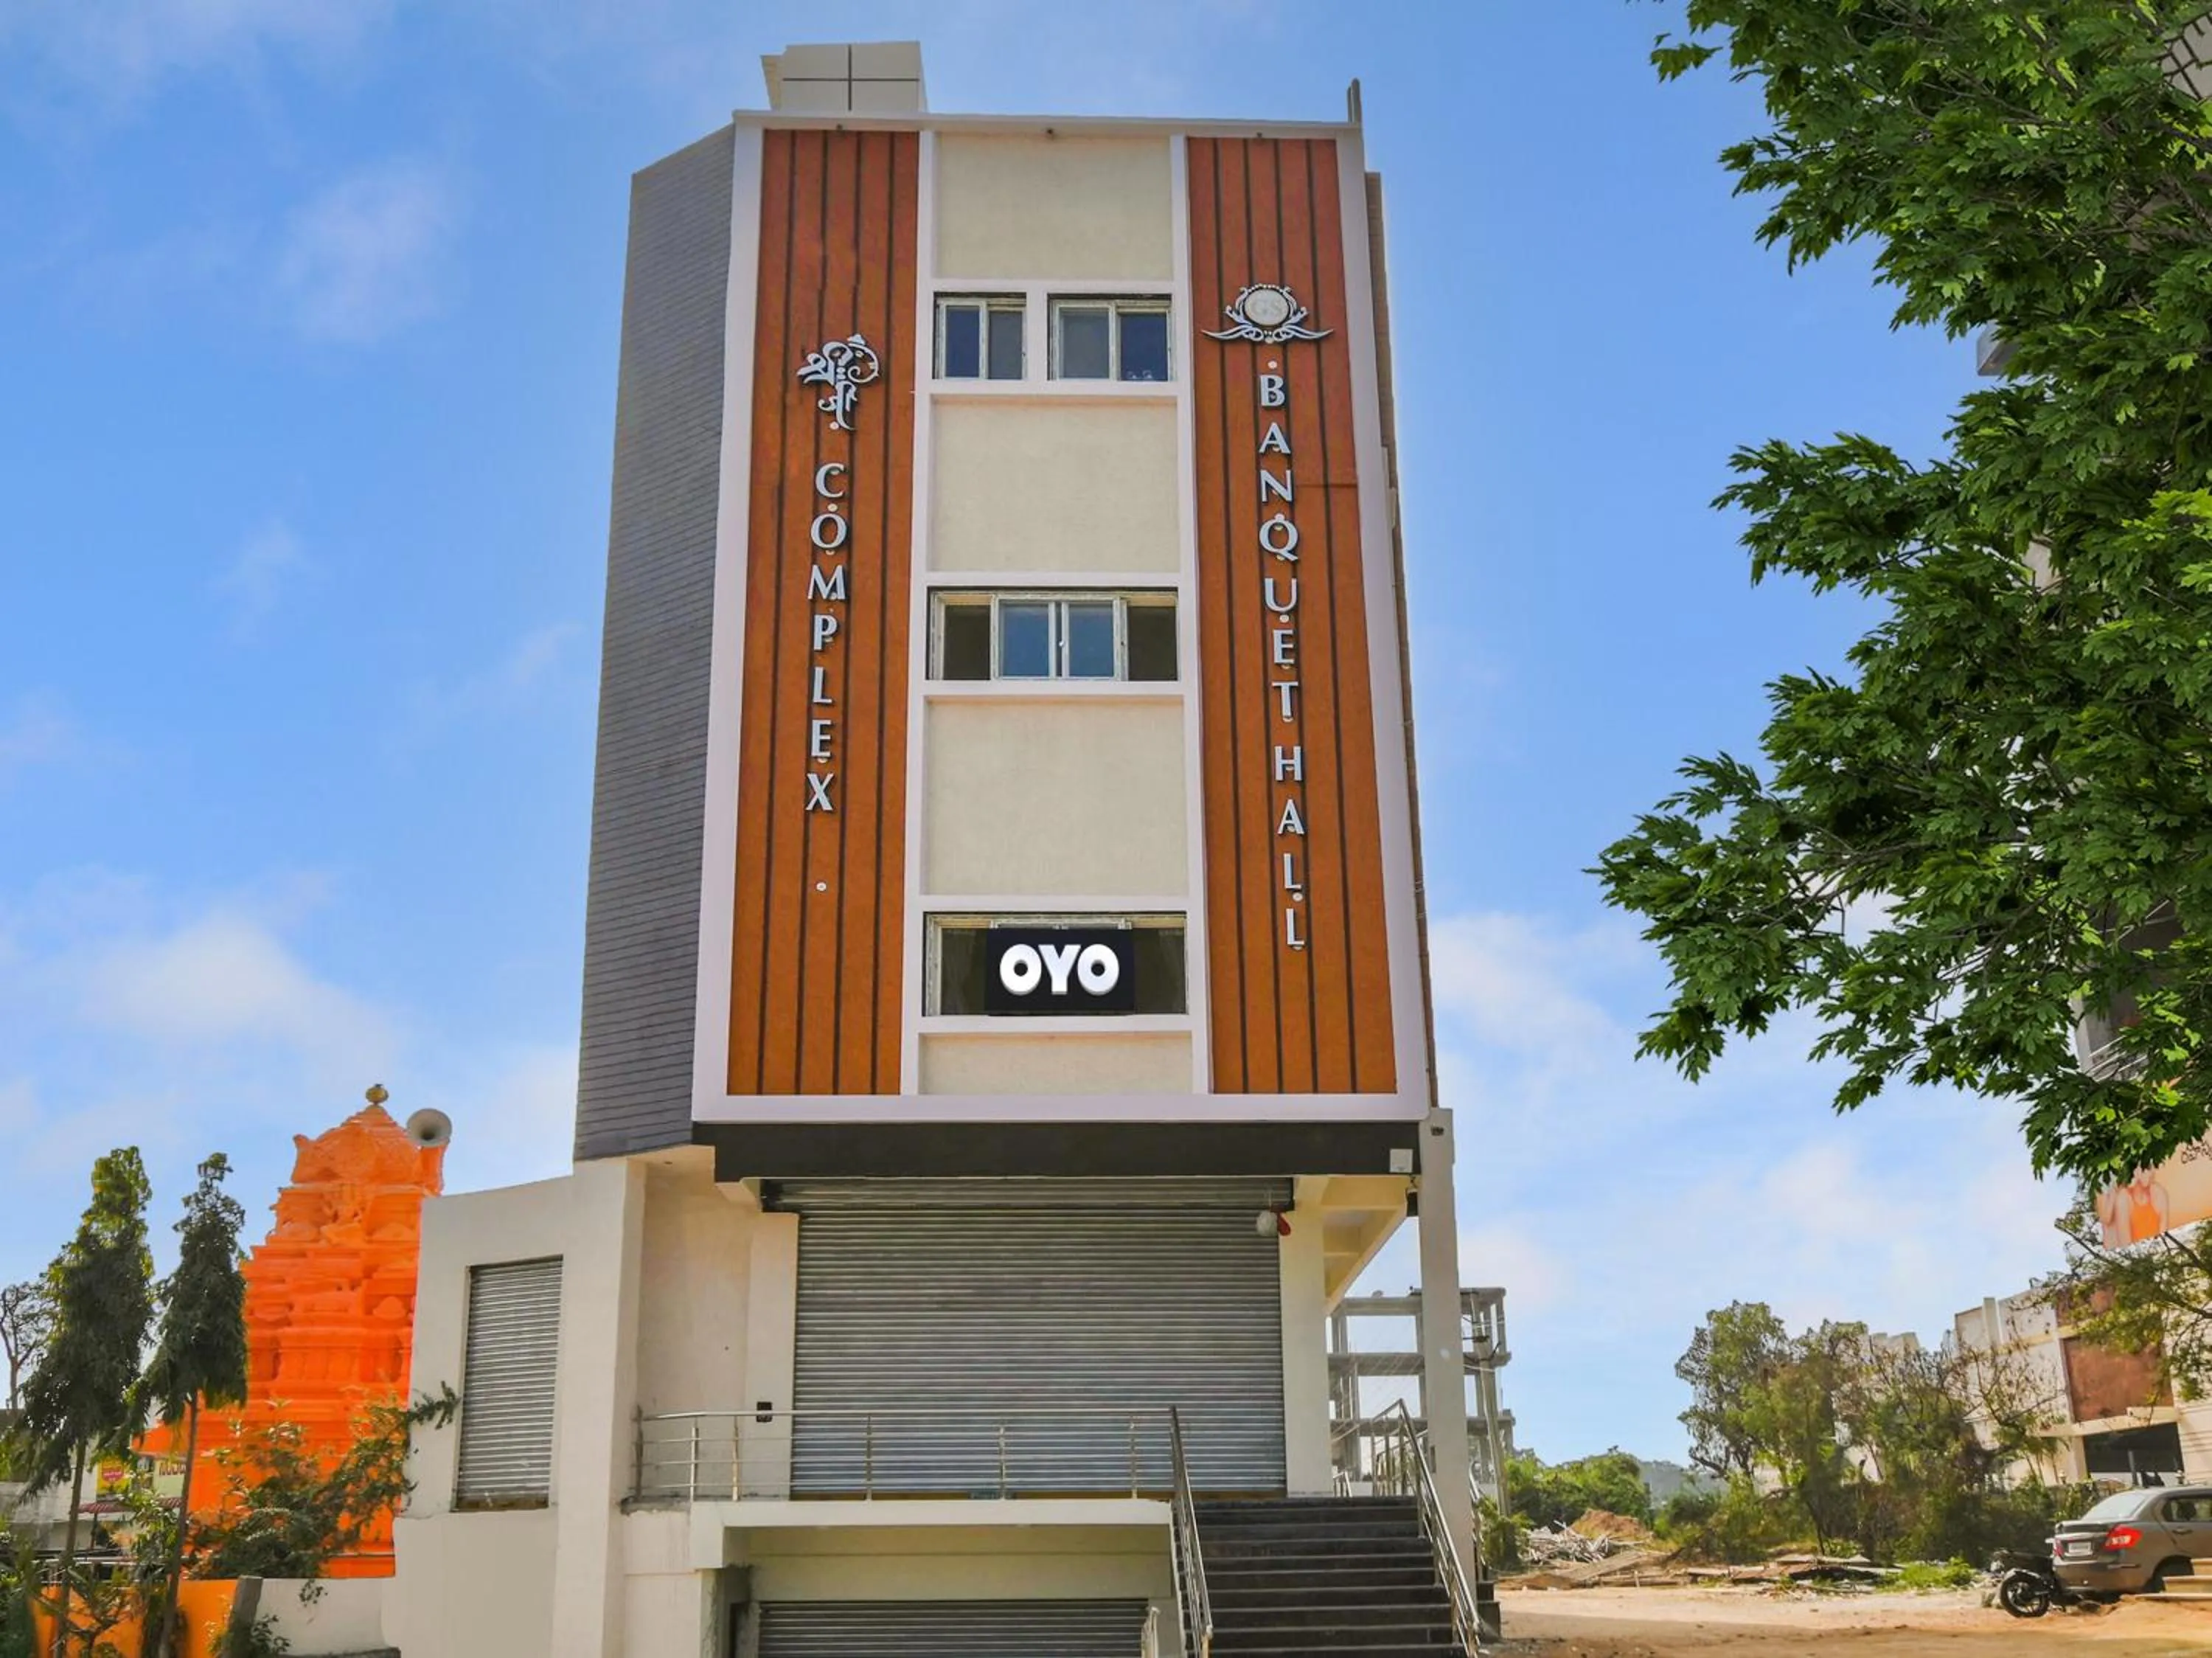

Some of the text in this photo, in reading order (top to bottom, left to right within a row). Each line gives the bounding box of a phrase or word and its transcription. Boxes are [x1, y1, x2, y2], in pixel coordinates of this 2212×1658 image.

[805, 462, 847, 811] COMPLEX
[1258, 374, 1305, 946] BANQUET HALL
[999, 943, 1119, 995] OYO
